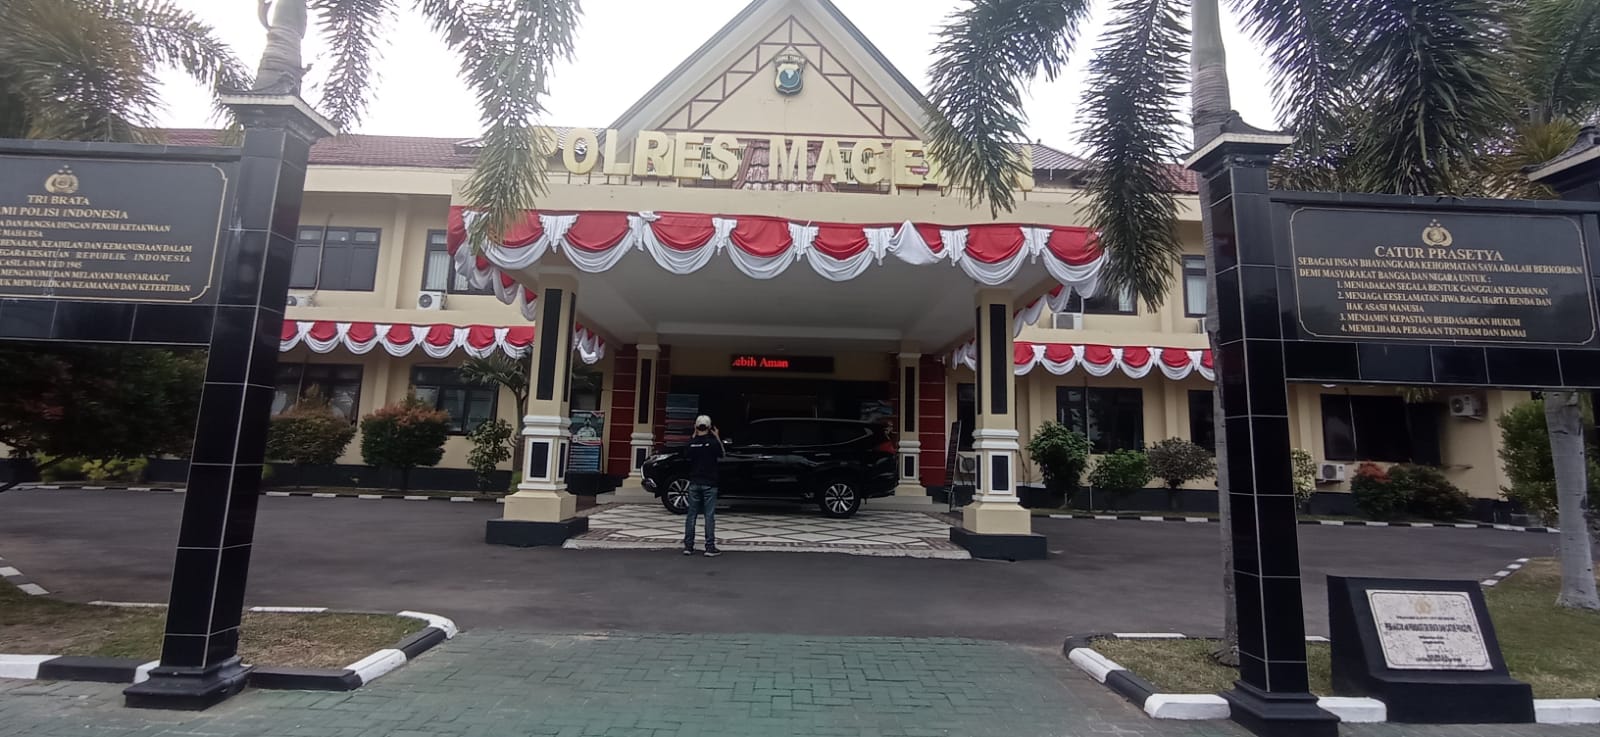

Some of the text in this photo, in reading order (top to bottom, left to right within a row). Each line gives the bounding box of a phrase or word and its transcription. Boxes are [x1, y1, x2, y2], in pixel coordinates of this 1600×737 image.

[533, 126, 1033, 192] POLRES MAGEN
[27, 194, 90, 206] TRI BRATA
[0, 206, 128, 219] MI POLISI INDONESIA
[6, 220, 22, 228] DAN
[23, 221, 56, 229] BANGSA
[57, 222, 90, 230] DENGAN
[91, 222, 119, 231] PENUH
[120, 223, 171, 232] KETAKWAAN
[3, 229, 26, 237] MAHA
[28, 230, 43, 238] ESA
[41, 240, 83, 249] KEADILAN
[84, 241, 101, 250] DAN
[102, 242, 163, 252] KEMANUSIAAN
[163, 244, 192, 253] DALAM
[1374, 245, 1504, 261] CATUR PRASETYA
[26, 249, 70, 258] KESATUAN
[76, 251, 127, 260] REPUBLIK
[134, 253, 191, 262] INDONESIA
[28, 260, 47, 268] DAN
[66, 261, 82, 269] 1945
[1298, 256, 1583, 274] SEBAGAI INSAN BHAYANGKARA KEHORMATAN SAYA ADALAH BERKORBAN
[1, 269, 171, 281] MENGAYOMI DAN MELAYANI MASYARAKAT
[1300, 268, 1321, 277] DEMI
[1322, 269, 1376, 279] MASYARAKAT
[1378, 271, 1410, 280] BANGSA
[1411, 272, 1429, 281] DAN
[1459, 273, 1487, 283] UNTUK
[72, 281, 120, 290] KEAMANAN
[120, 282, 138, 291] DAN
[139, 283, 191, 292] KETERTIBAN
[1336, 280, 1549, 296] 1. MENIADAKAN SEGALA BENTUK GANGGUAN KEAMANAN
[1337, 291, 1552, 306] 2. MENJAGA KESELAMATAN JIWA RAGA HARTA BENDA DAN
[1346, 302, 1425, 313] HAK ASASI MANUSIA
[1339, 313, 1521, 327] 3. MENJAMIN KEPASTIAN BERDASARKAN HUKUM
[1341, 324, 1527, 338] 4. MEMELIHARA PERASAAN TENTRAM DAN DAMAI
[760, 357, 789, 368] Aman
